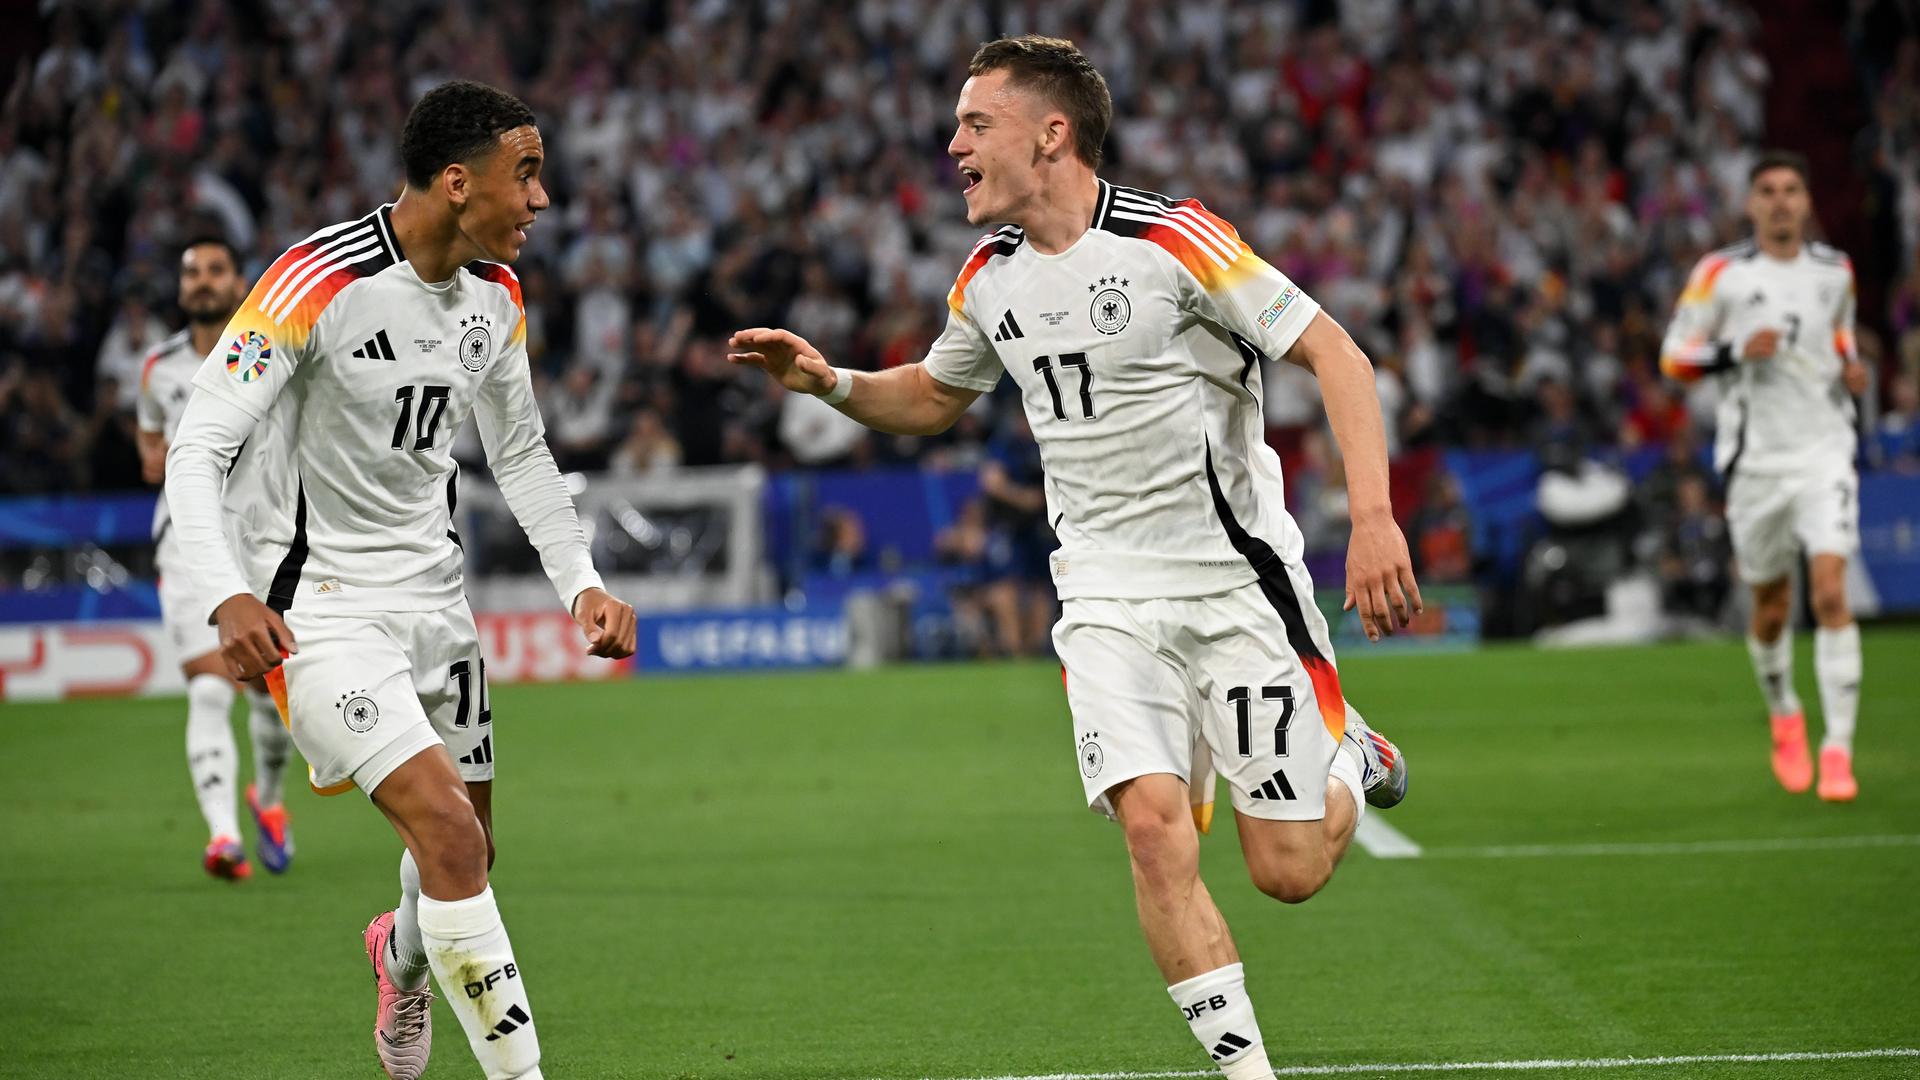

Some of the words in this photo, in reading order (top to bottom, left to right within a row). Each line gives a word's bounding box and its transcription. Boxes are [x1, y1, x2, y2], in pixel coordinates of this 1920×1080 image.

[391, 385, 451, 452] 10
[1032, 352, 1096, 421] 17
[1227, 686, 1297, 757] 17
[464, 963, 517, 998] DFB
[1182, 994, 1227, 1021] DFB
